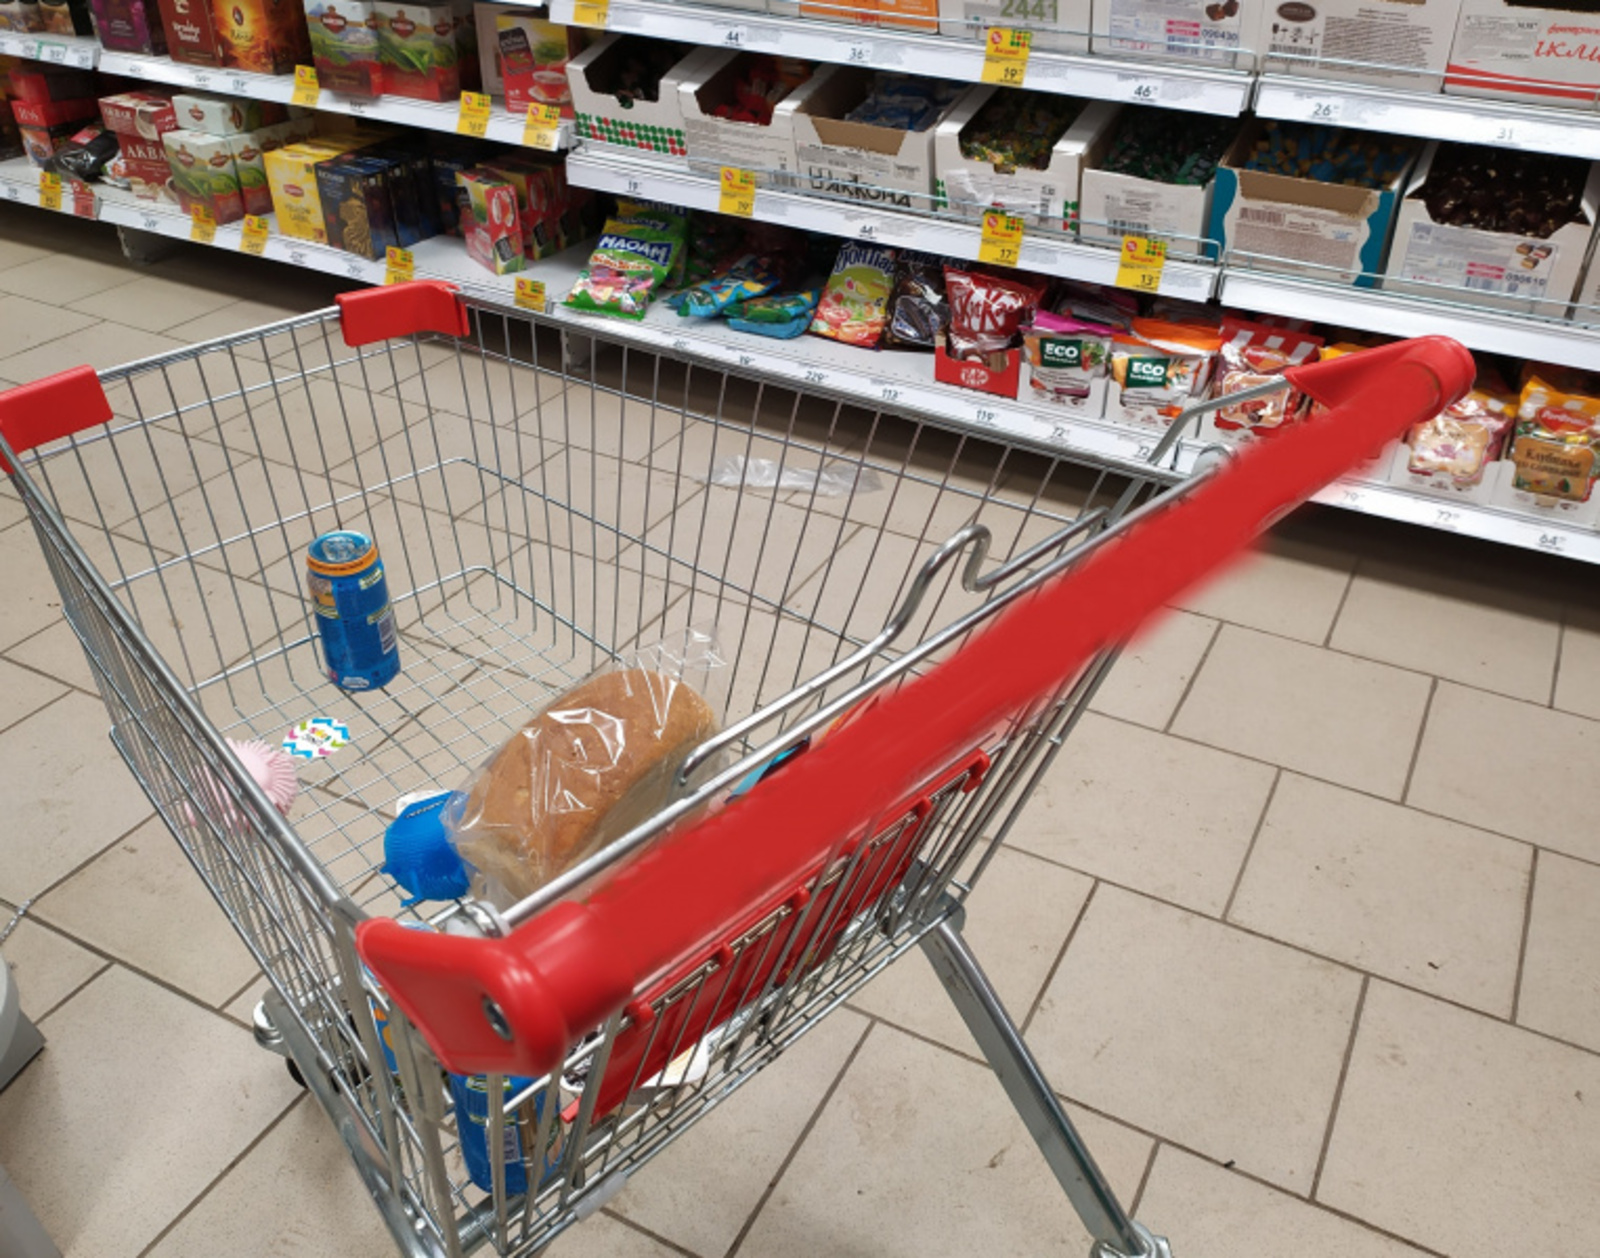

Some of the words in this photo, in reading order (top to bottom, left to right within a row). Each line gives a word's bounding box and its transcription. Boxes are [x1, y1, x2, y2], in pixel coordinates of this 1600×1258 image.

[1001, 0, 1057, 23] 2441
[127, 144, 168, 161] AKBA
[600, 236, 668, 266] MAOAM
[1044, 342, 1079, 359] ECO
[1131, 360, 1165, 377] ECO
